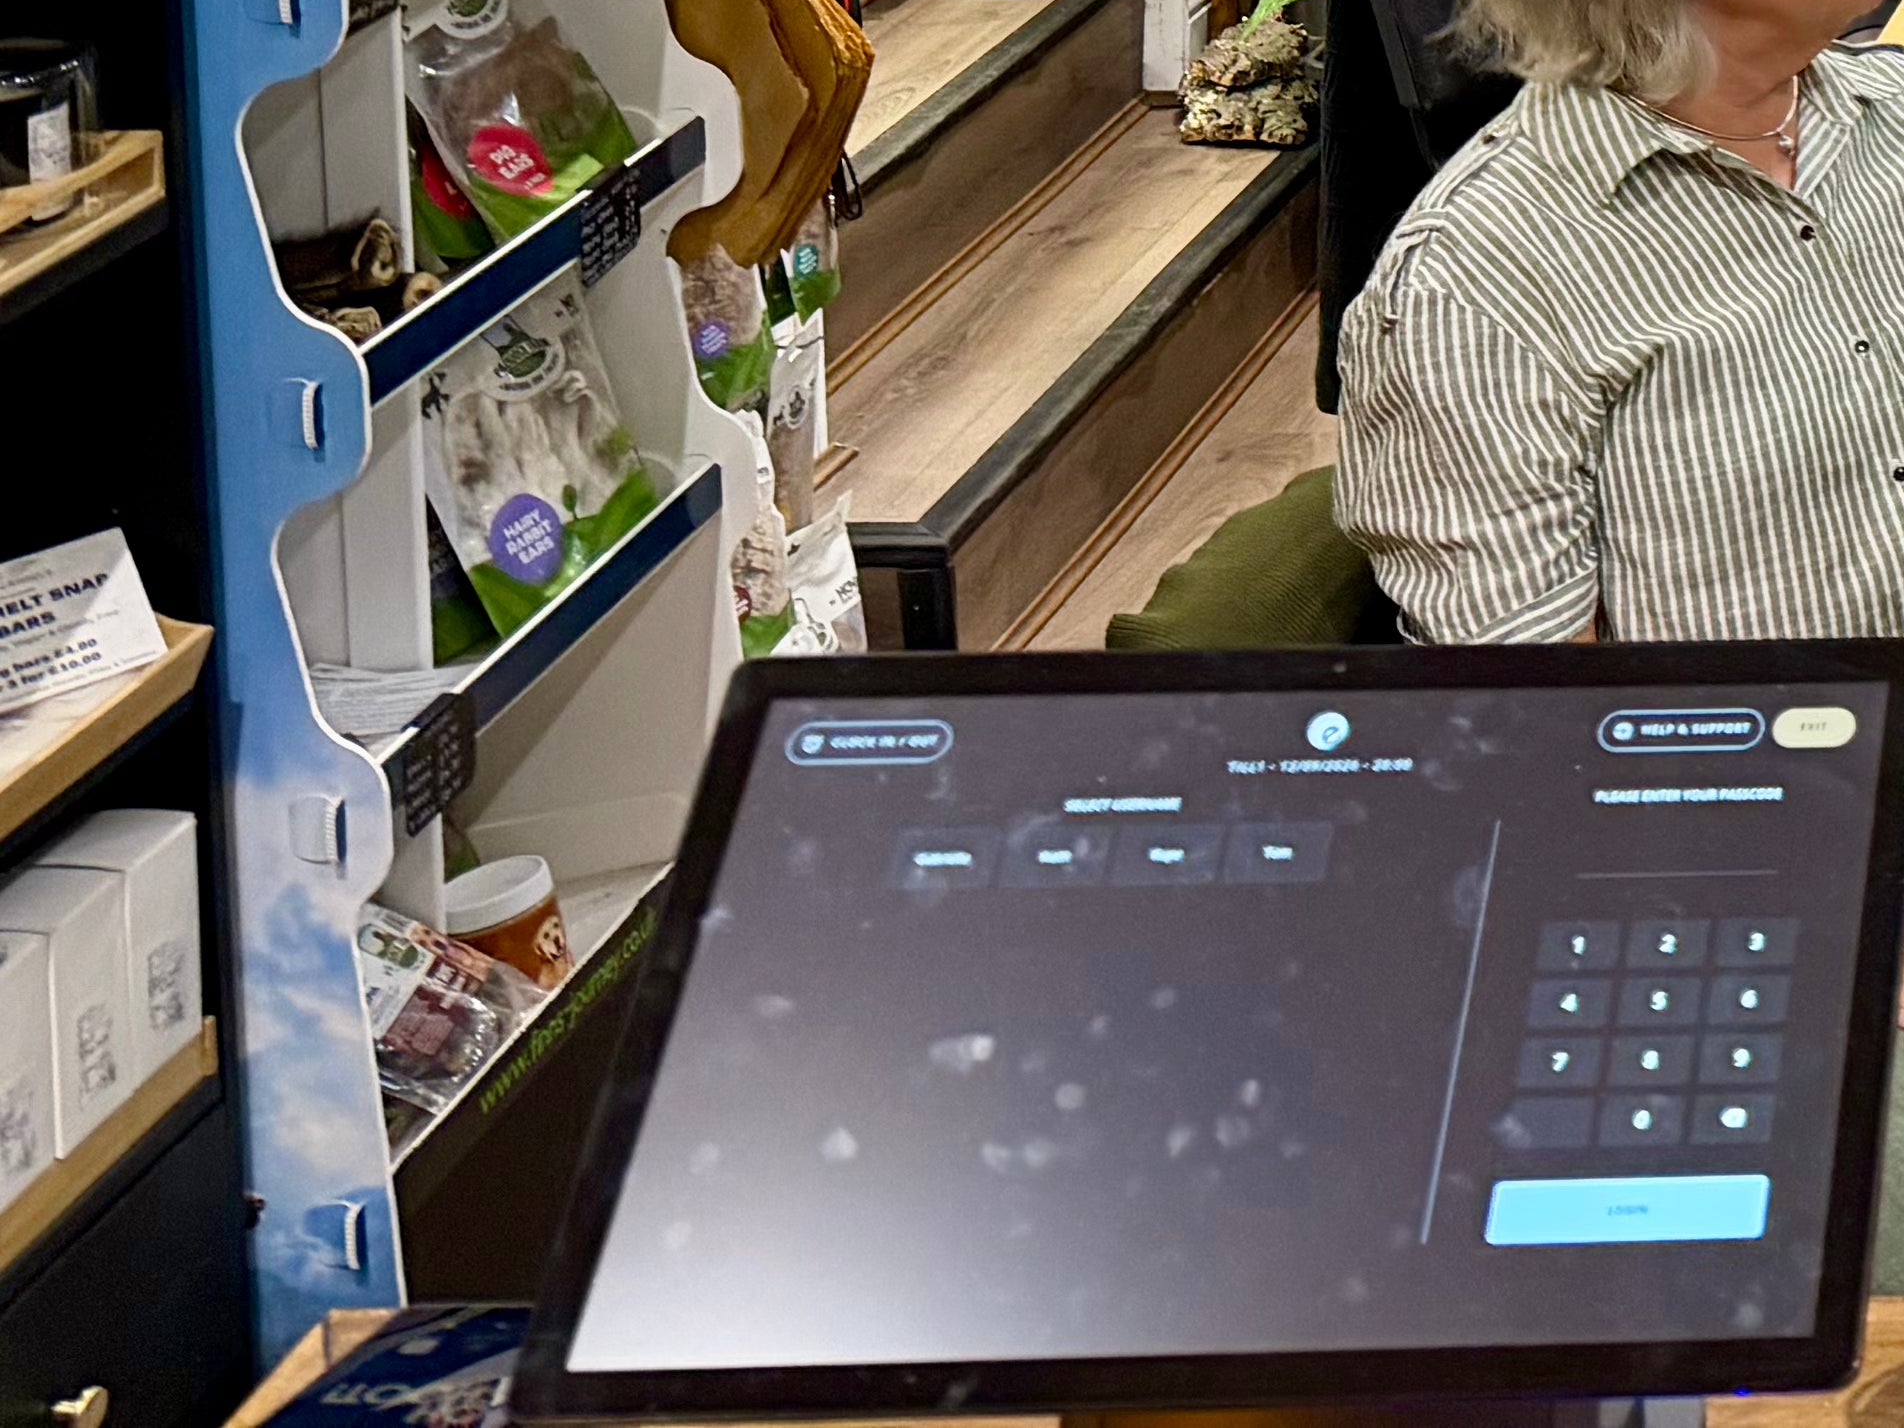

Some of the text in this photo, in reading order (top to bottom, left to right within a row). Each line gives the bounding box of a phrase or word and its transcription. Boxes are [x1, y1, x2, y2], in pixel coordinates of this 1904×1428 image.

[503, 507, 541, 539] HAIRY
[505, 519, 552, 557] RABBIT
[518, 535, 555, 564] EARS
[48, 572, 109, 603] SNAP
[12, 654, 51, 674] bars
[21, 671, 44, 686] for
[1640, 723, 1675, 737] HELP
[1690, 721, 1752, 736] SUPPORT
[1594, 787, 1783, 804] PLEASE ENTER YOUR PASSCODE
[1658, 933, 1678, 955] 2
[1747, 932, 1767, 953] 3
[1559, 993, 1579, 1014] 4
[1650, 990, 1669, 1011] 5
[1552, 1051, 1570, 1073] 7
[1731, 1047, 1751, 1068] 9
